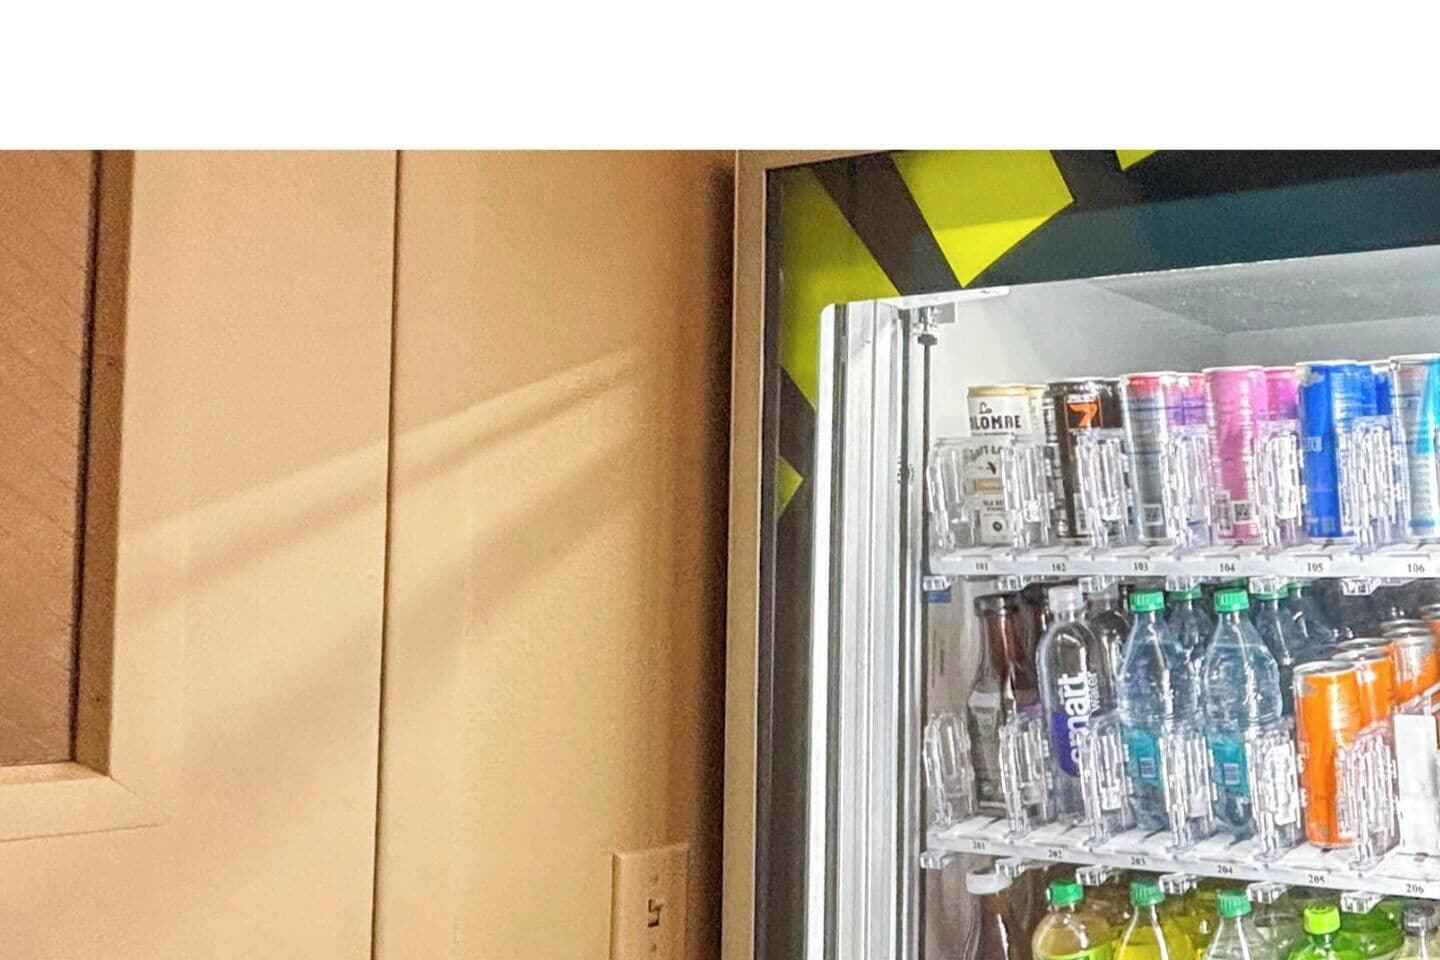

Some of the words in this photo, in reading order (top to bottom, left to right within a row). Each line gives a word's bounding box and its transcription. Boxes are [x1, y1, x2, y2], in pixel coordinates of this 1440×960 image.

[1052, 563, 1066, 572] 102
[1219, 563, 1235, 572] 104
[1307, 562, 1323, 572] 105
[1408, 563, 1424, 573] 106
[1217, 865, 1233, 874] 204
[1308, 874, 1325, 884] 205
[1406, 883, 1424, 893] 206
